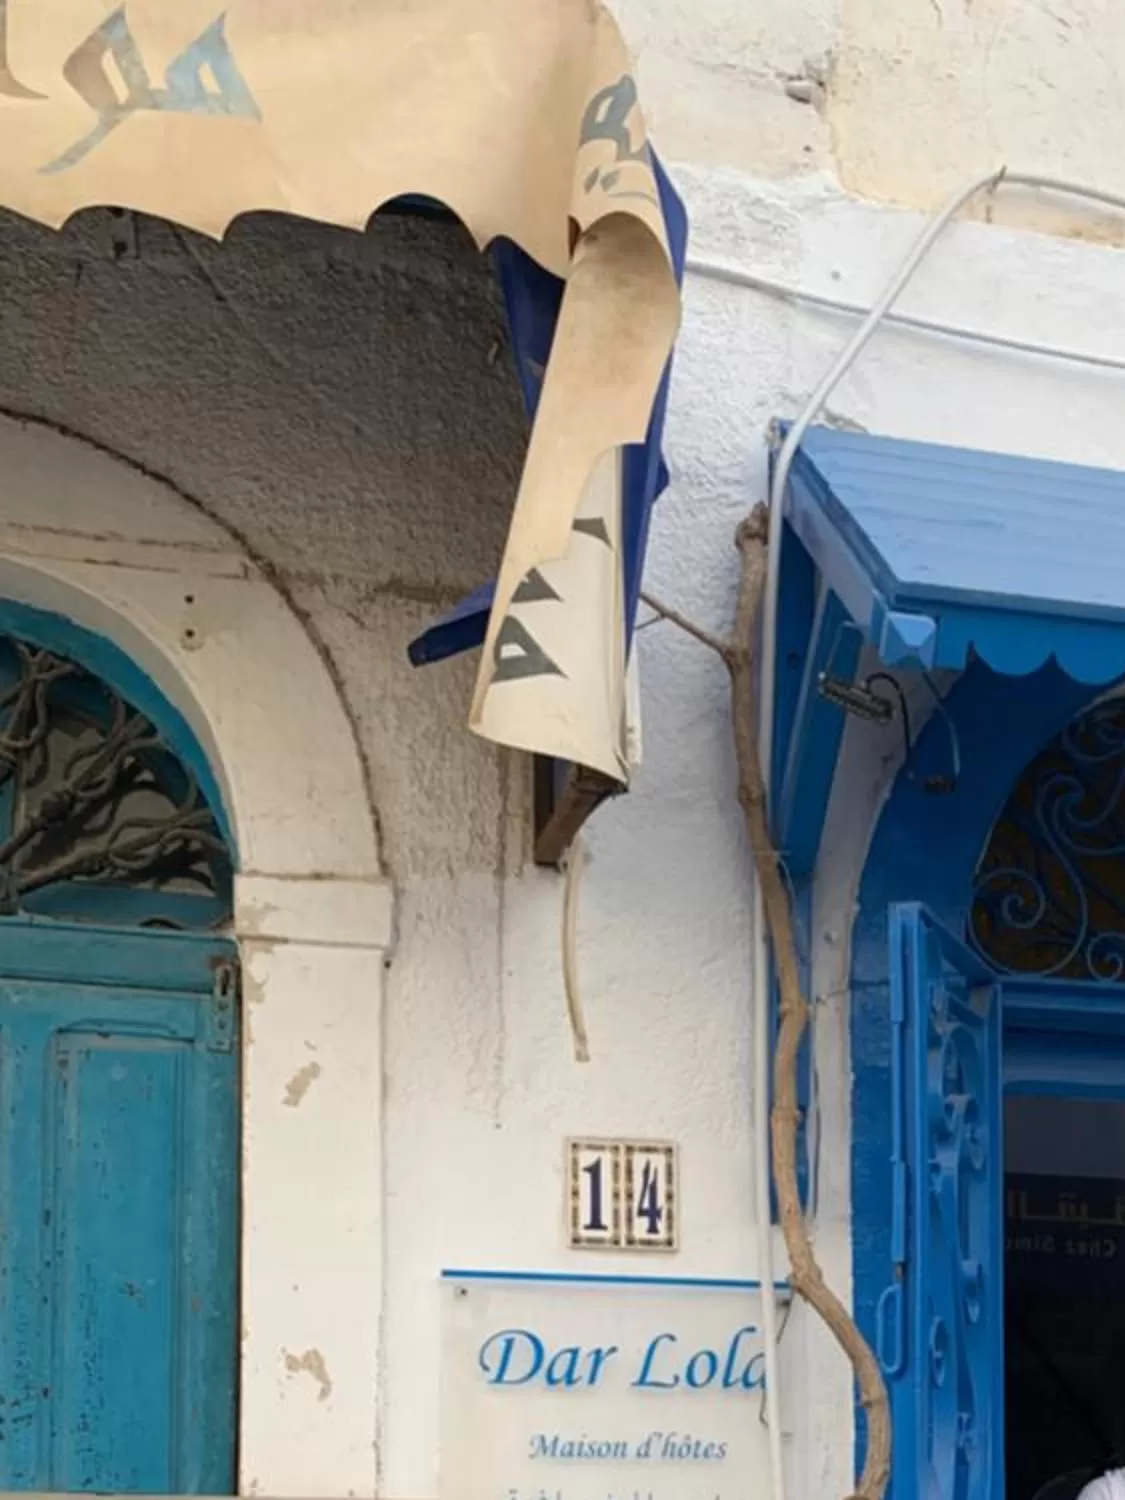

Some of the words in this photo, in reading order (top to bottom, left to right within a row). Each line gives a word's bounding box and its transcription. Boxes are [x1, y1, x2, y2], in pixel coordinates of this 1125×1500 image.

[582, 1156, 662, 1235] 14
[479, 1328, 618, 1388] Dar
[631, 1325, 768, 1389] Lola
[528, 1432, 628, 1460] Maison
[636, 1430, 728, 1461] d'hôtes
